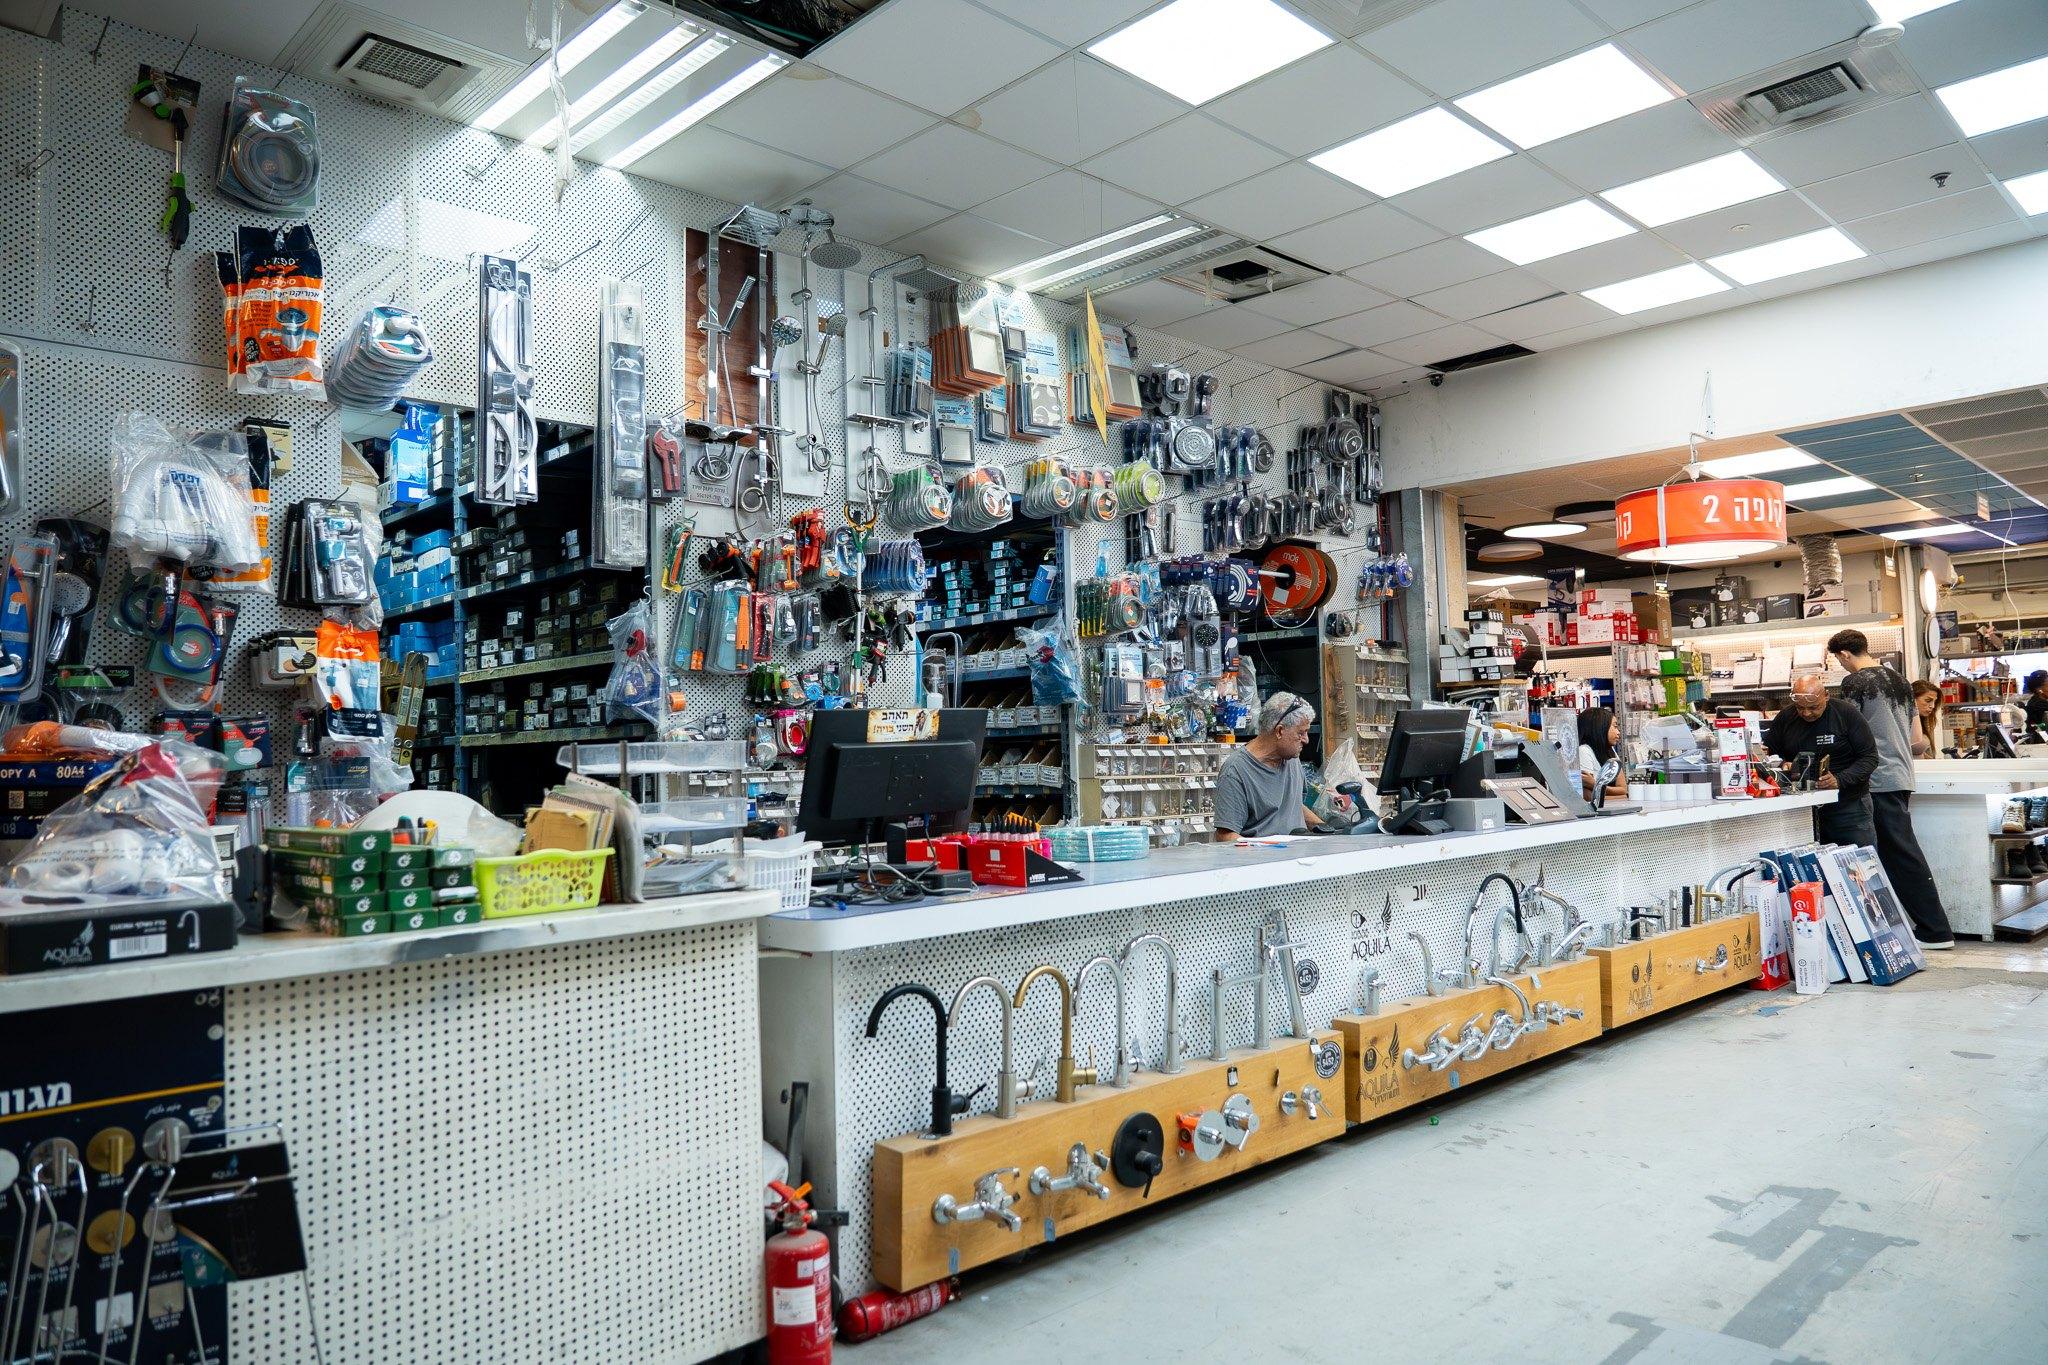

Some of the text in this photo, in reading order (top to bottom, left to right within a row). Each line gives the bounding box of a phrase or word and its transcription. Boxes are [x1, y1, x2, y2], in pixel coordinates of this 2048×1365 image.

[1703, 495, 1782, 528] קופה 2
[881, 711, 909, 721] תאהב
[1519, 901, 1546, 920] QUILA
[43, 944, 93, 962] AQUILA
[1351, 935, 1392, 961] AQUILA
[1733, 953, 1752, 971] AQUILA
[1356, 1070, 1400, 1102] AQUILA
[1374, 1087, 1400, 1108] premium
